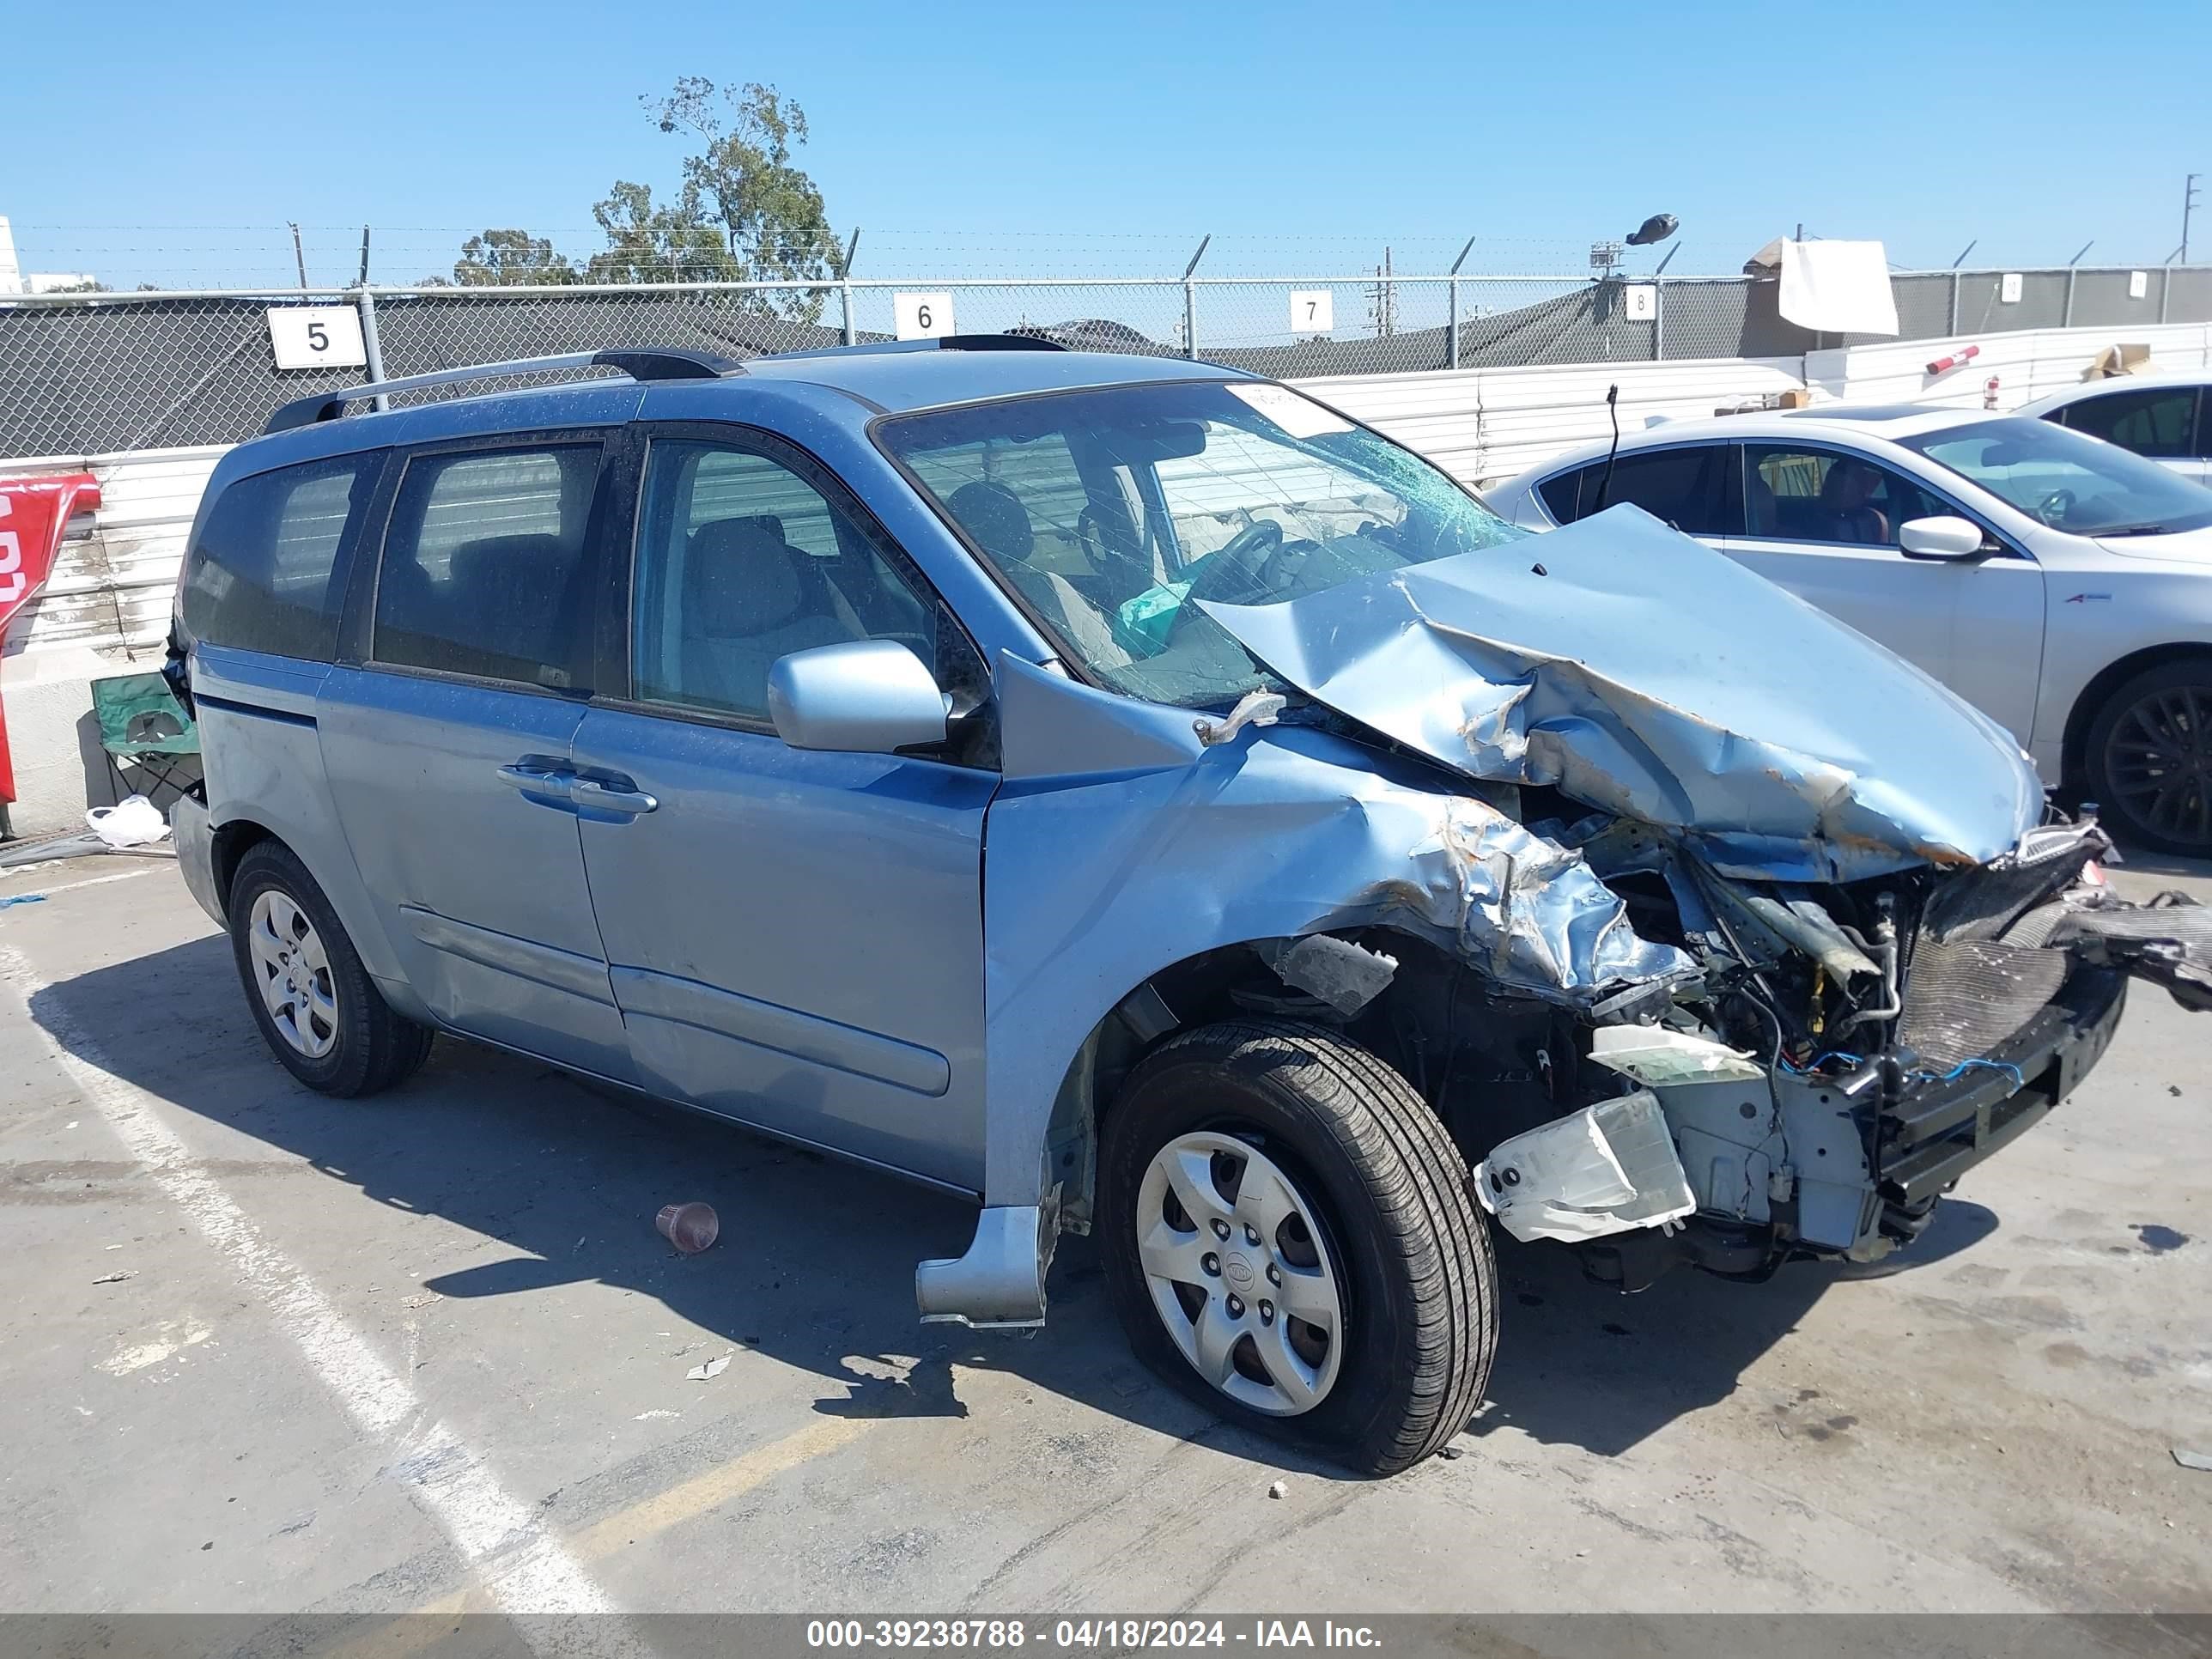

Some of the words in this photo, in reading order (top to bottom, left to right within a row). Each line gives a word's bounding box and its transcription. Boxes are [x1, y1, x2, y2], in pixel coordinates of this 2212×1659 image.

[1306, 301, 1316, 320] 7
[1638, 295, 1644, 311] 8
[918, 305, 932, 329] 6
[308, 323, 329, 351] 5
